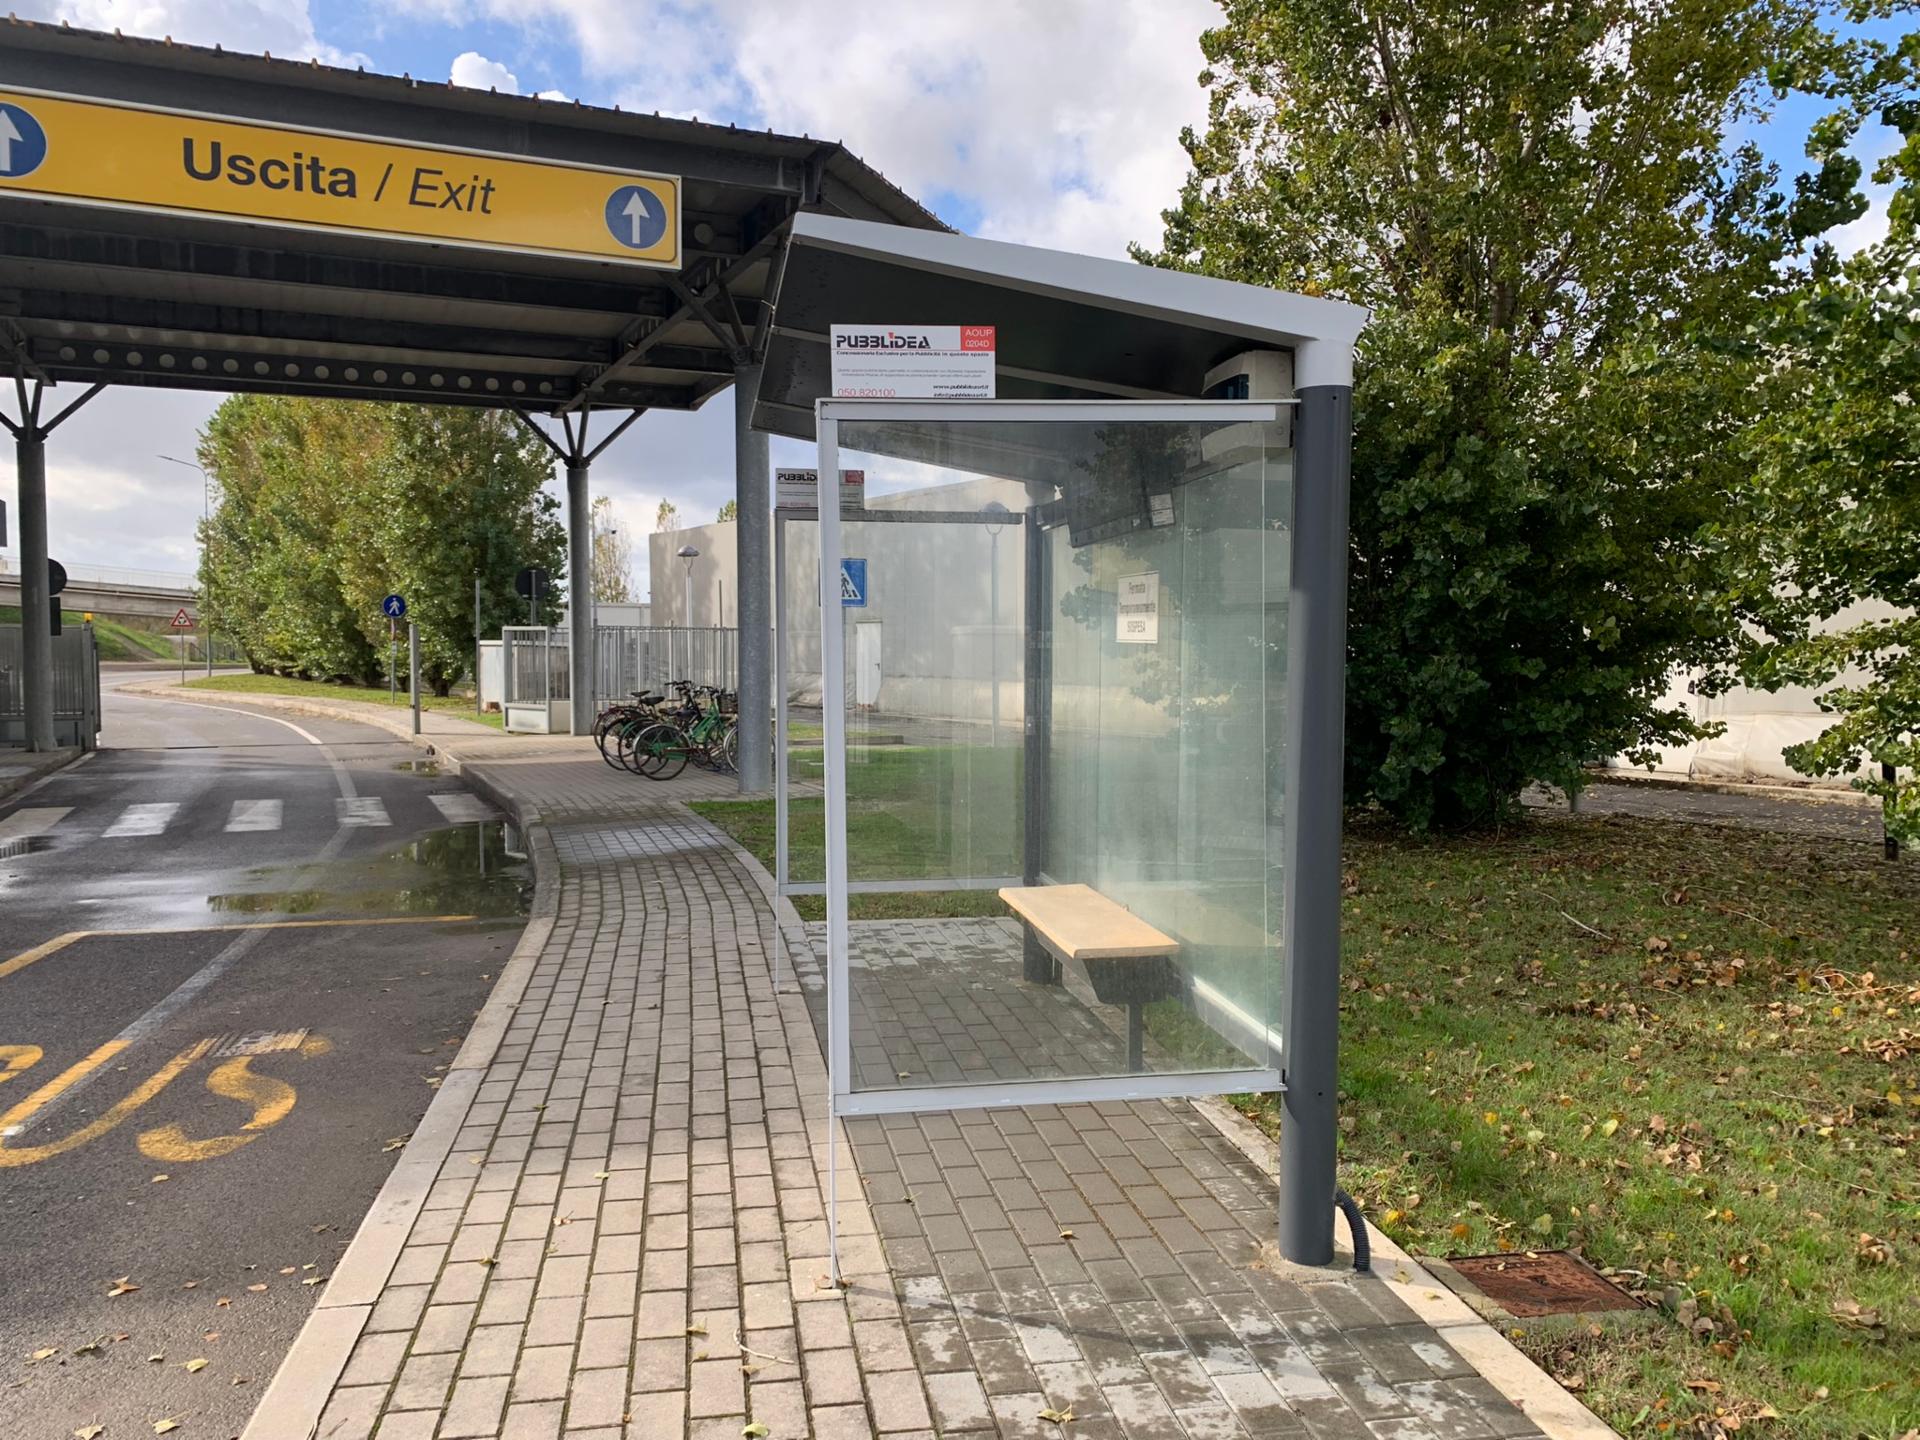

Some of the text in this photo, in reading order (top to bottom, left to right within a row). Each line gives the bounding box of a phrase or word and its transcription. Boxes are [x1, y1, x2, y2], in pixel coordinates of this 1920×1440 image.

[182, 137, 496, 215] Uscita / Exit
[965, 328, 993, 337] AOUP
[837, 388, 896, 397] 050 820100
